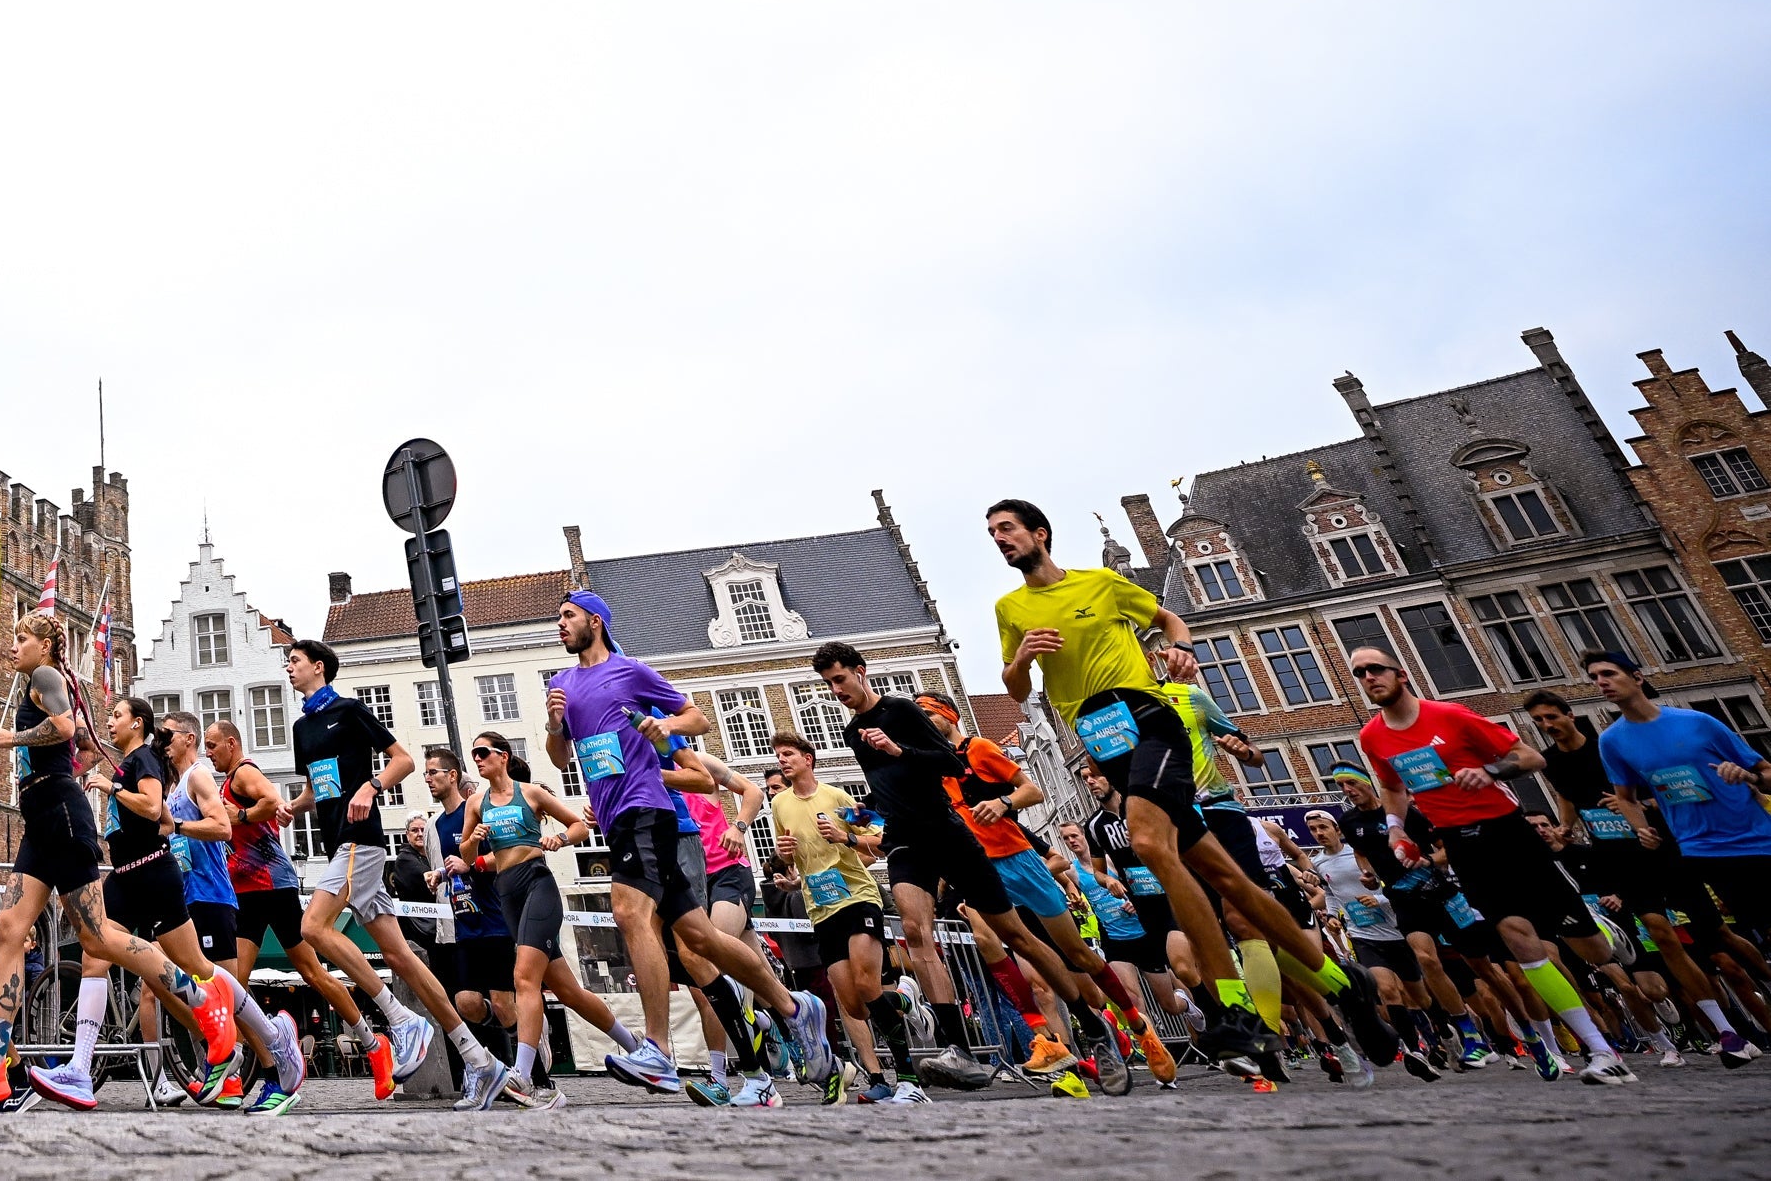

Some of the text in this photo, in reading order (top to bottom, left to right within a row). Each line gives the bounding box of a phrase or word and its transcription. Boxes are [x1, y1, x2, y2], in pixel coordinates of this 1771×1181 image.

[1093, 709, 1124, 727] ATHORA
[586, 737, 614, 749] ATHORA
[591, 748, 611, 761] JUSTIN
[1403, 751, 1433, 765] ATHORA
[1661, 770, 1693, 780] ATHORA
[494, 809, 518, 818] ATHORA
[495, 817, 518, 827] JULIETTE
[1592, 820, 1632, 832] 12335
[814, 873, 837, 883] ATHORA
[820, 881, 836, 891] BERT
[411, 905, 438, 915] ATHORA
